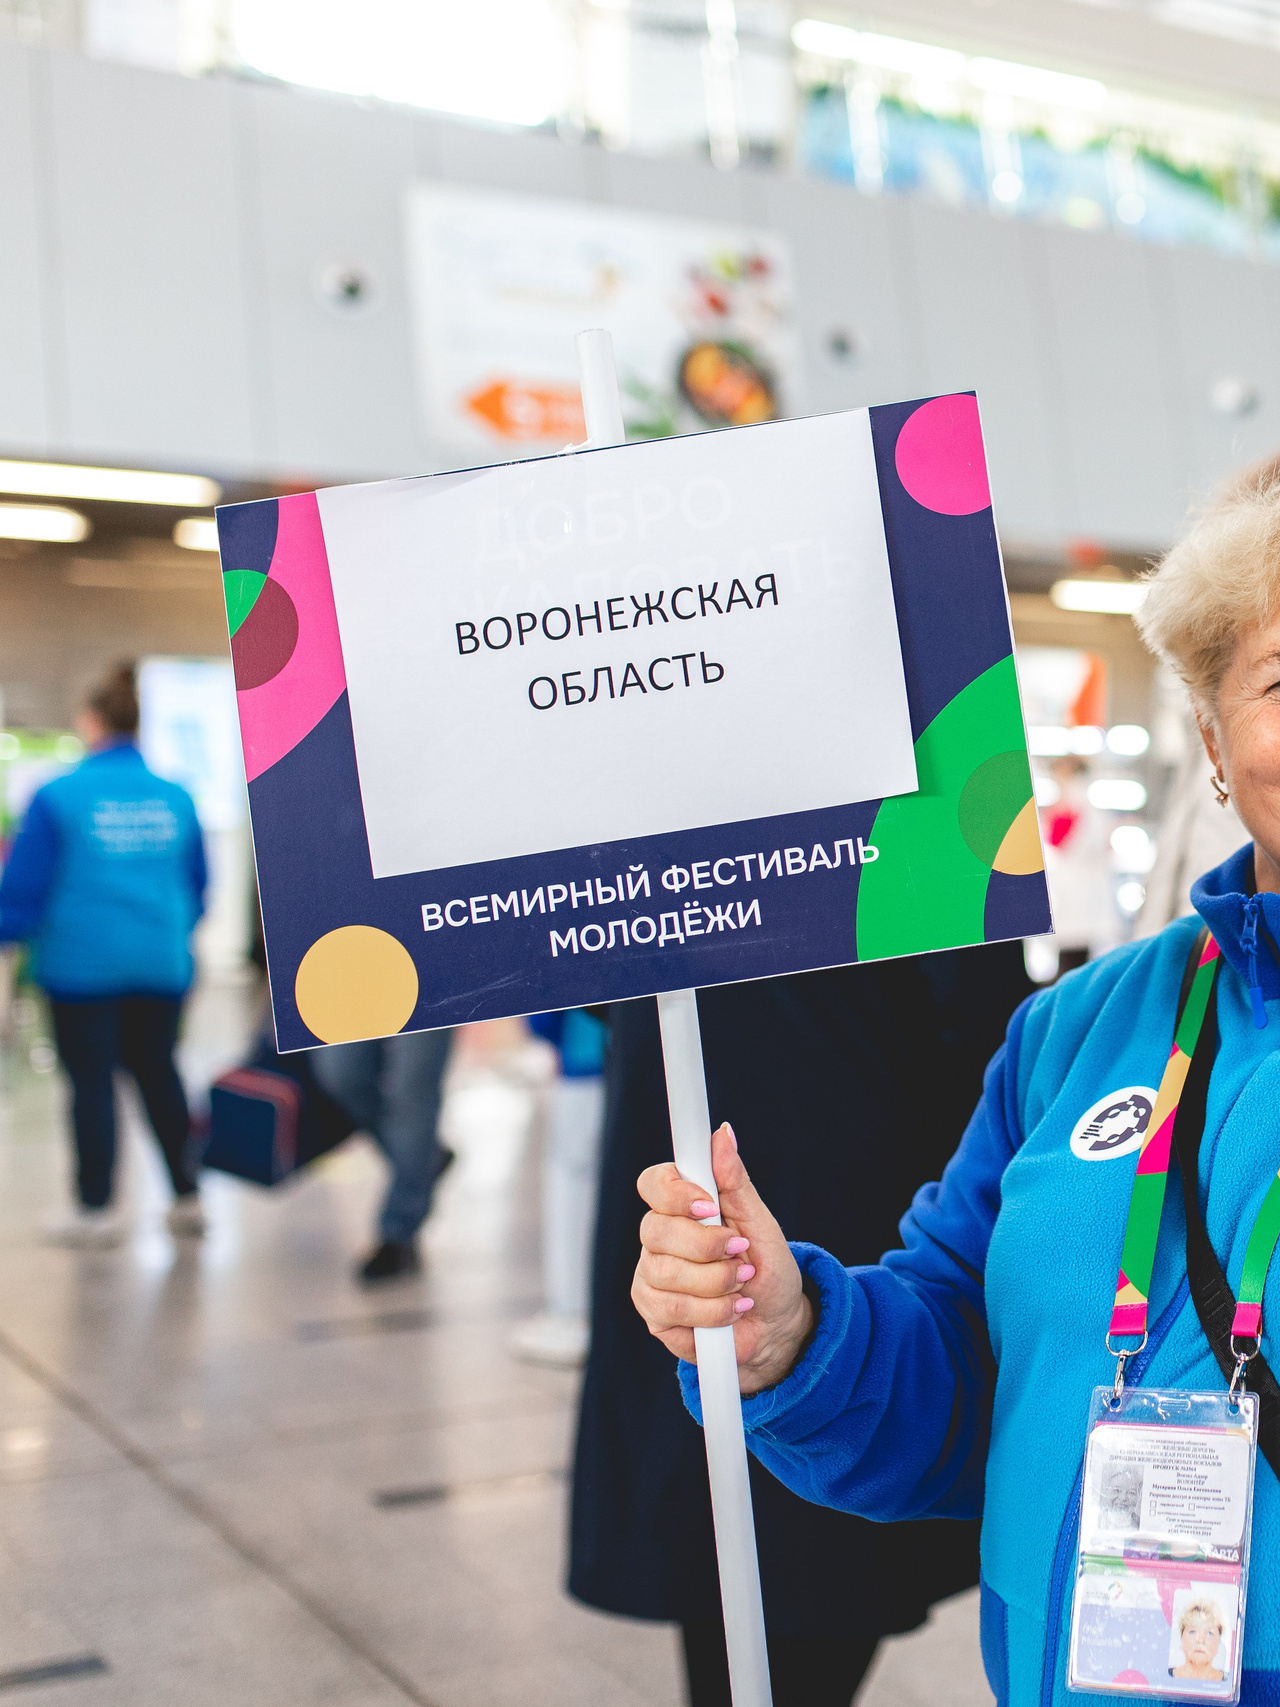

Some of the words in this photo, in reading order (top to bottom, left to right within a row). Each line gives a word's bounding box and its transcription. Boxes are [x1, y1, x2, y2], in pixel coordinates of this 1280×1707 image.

[456, 574, 779, 655] ВОРОНЕЖСКАЯ
[527, 651, 725, 709] ОБЛАСТЬ
[421, 863, 651, 935] ВСЕМИРНЫЙ
[661, 836, 881, 894] ФЕСТИВАЛЬ
[550, 898, 762, 957] МОЛОДЁЖИ
